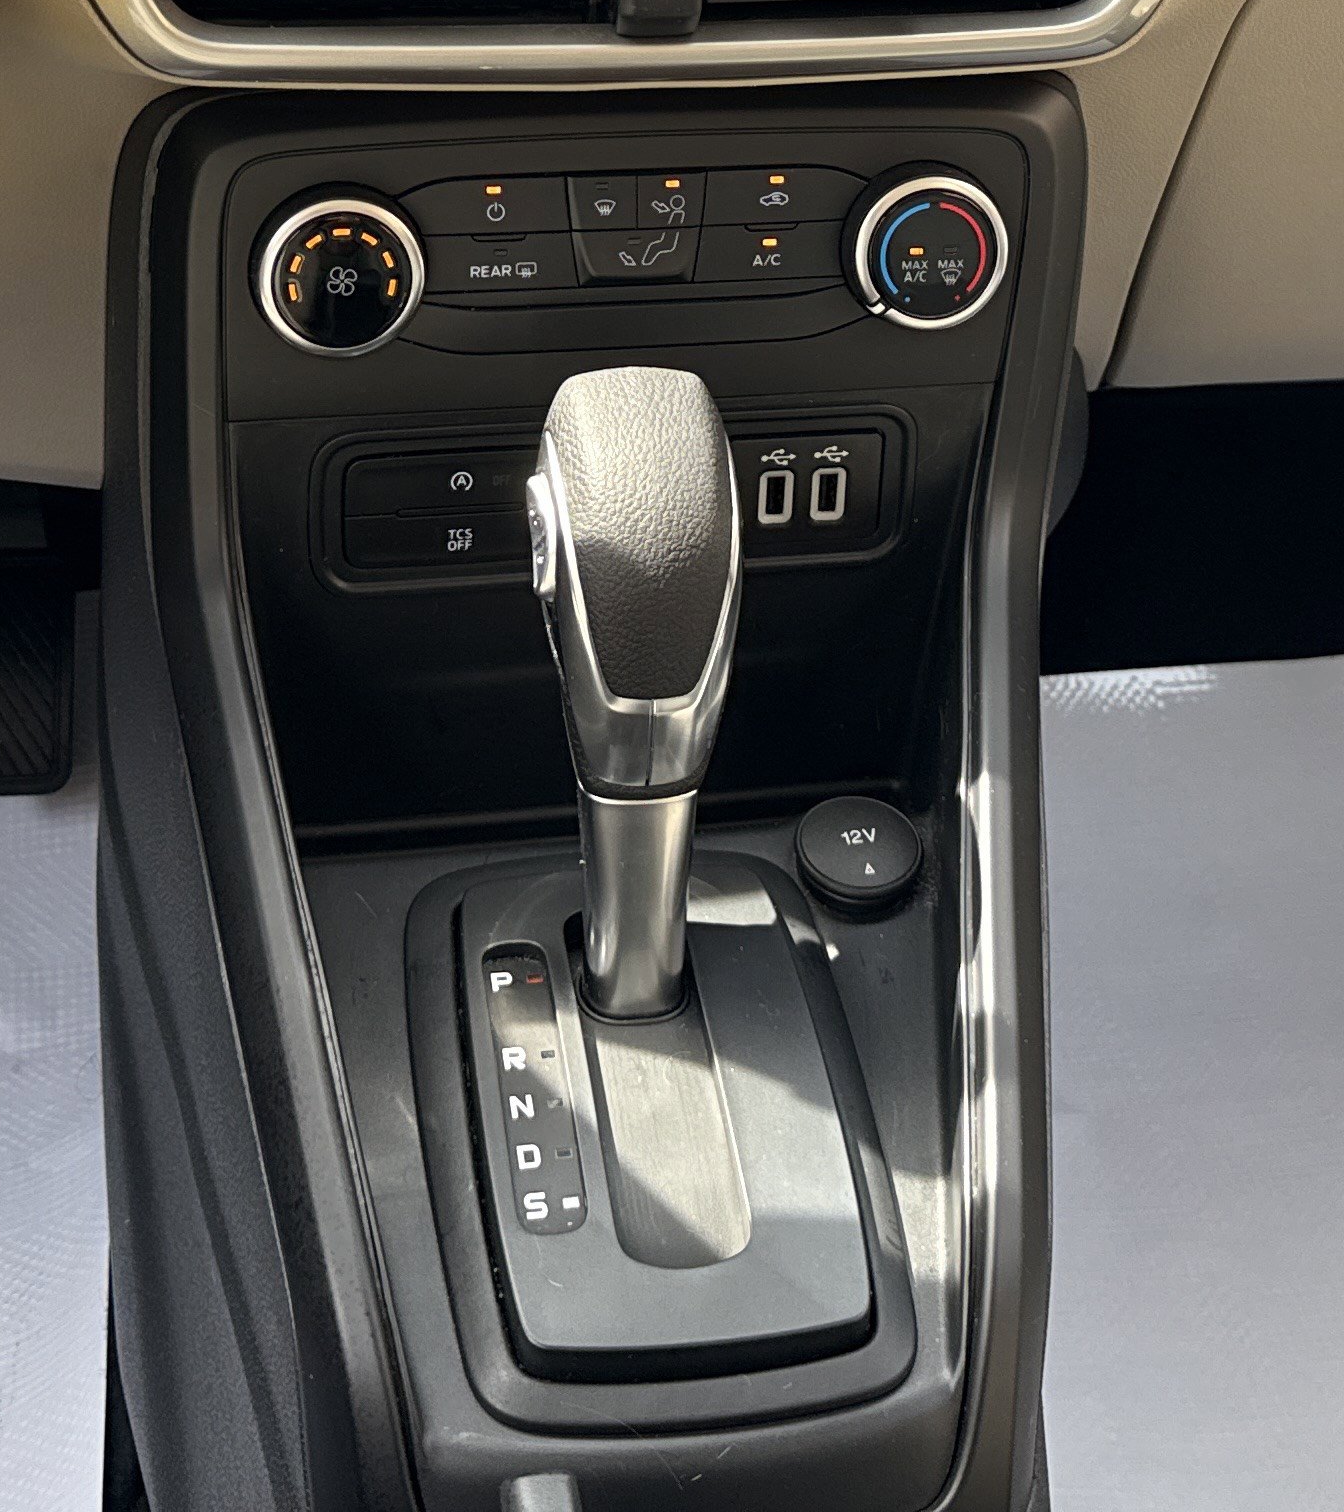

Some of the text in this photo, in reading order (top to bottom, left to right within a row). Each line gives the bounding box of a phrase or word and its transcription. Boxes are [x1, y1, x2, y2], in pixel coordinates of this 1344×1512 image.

[752, 252, 782, 268] A/C
[900, 258, 929, 271] MAX
[936, 257, 965, 270] MAX
[470, 263, 512, 279] REAR
[903, 270, 928, 284] A/C
[447, 528, 473, 541] TCS
[447, 540, 473, 552] OFF
[840, 827, 877, 846] 12V
[489, 972, 514, 992] P
[501, 1046, 527, 1071] R
[509, 1094, 535, 1119] N
[516, 1143, 542, 1170] D
[523, 1192, 549, 1221] S
